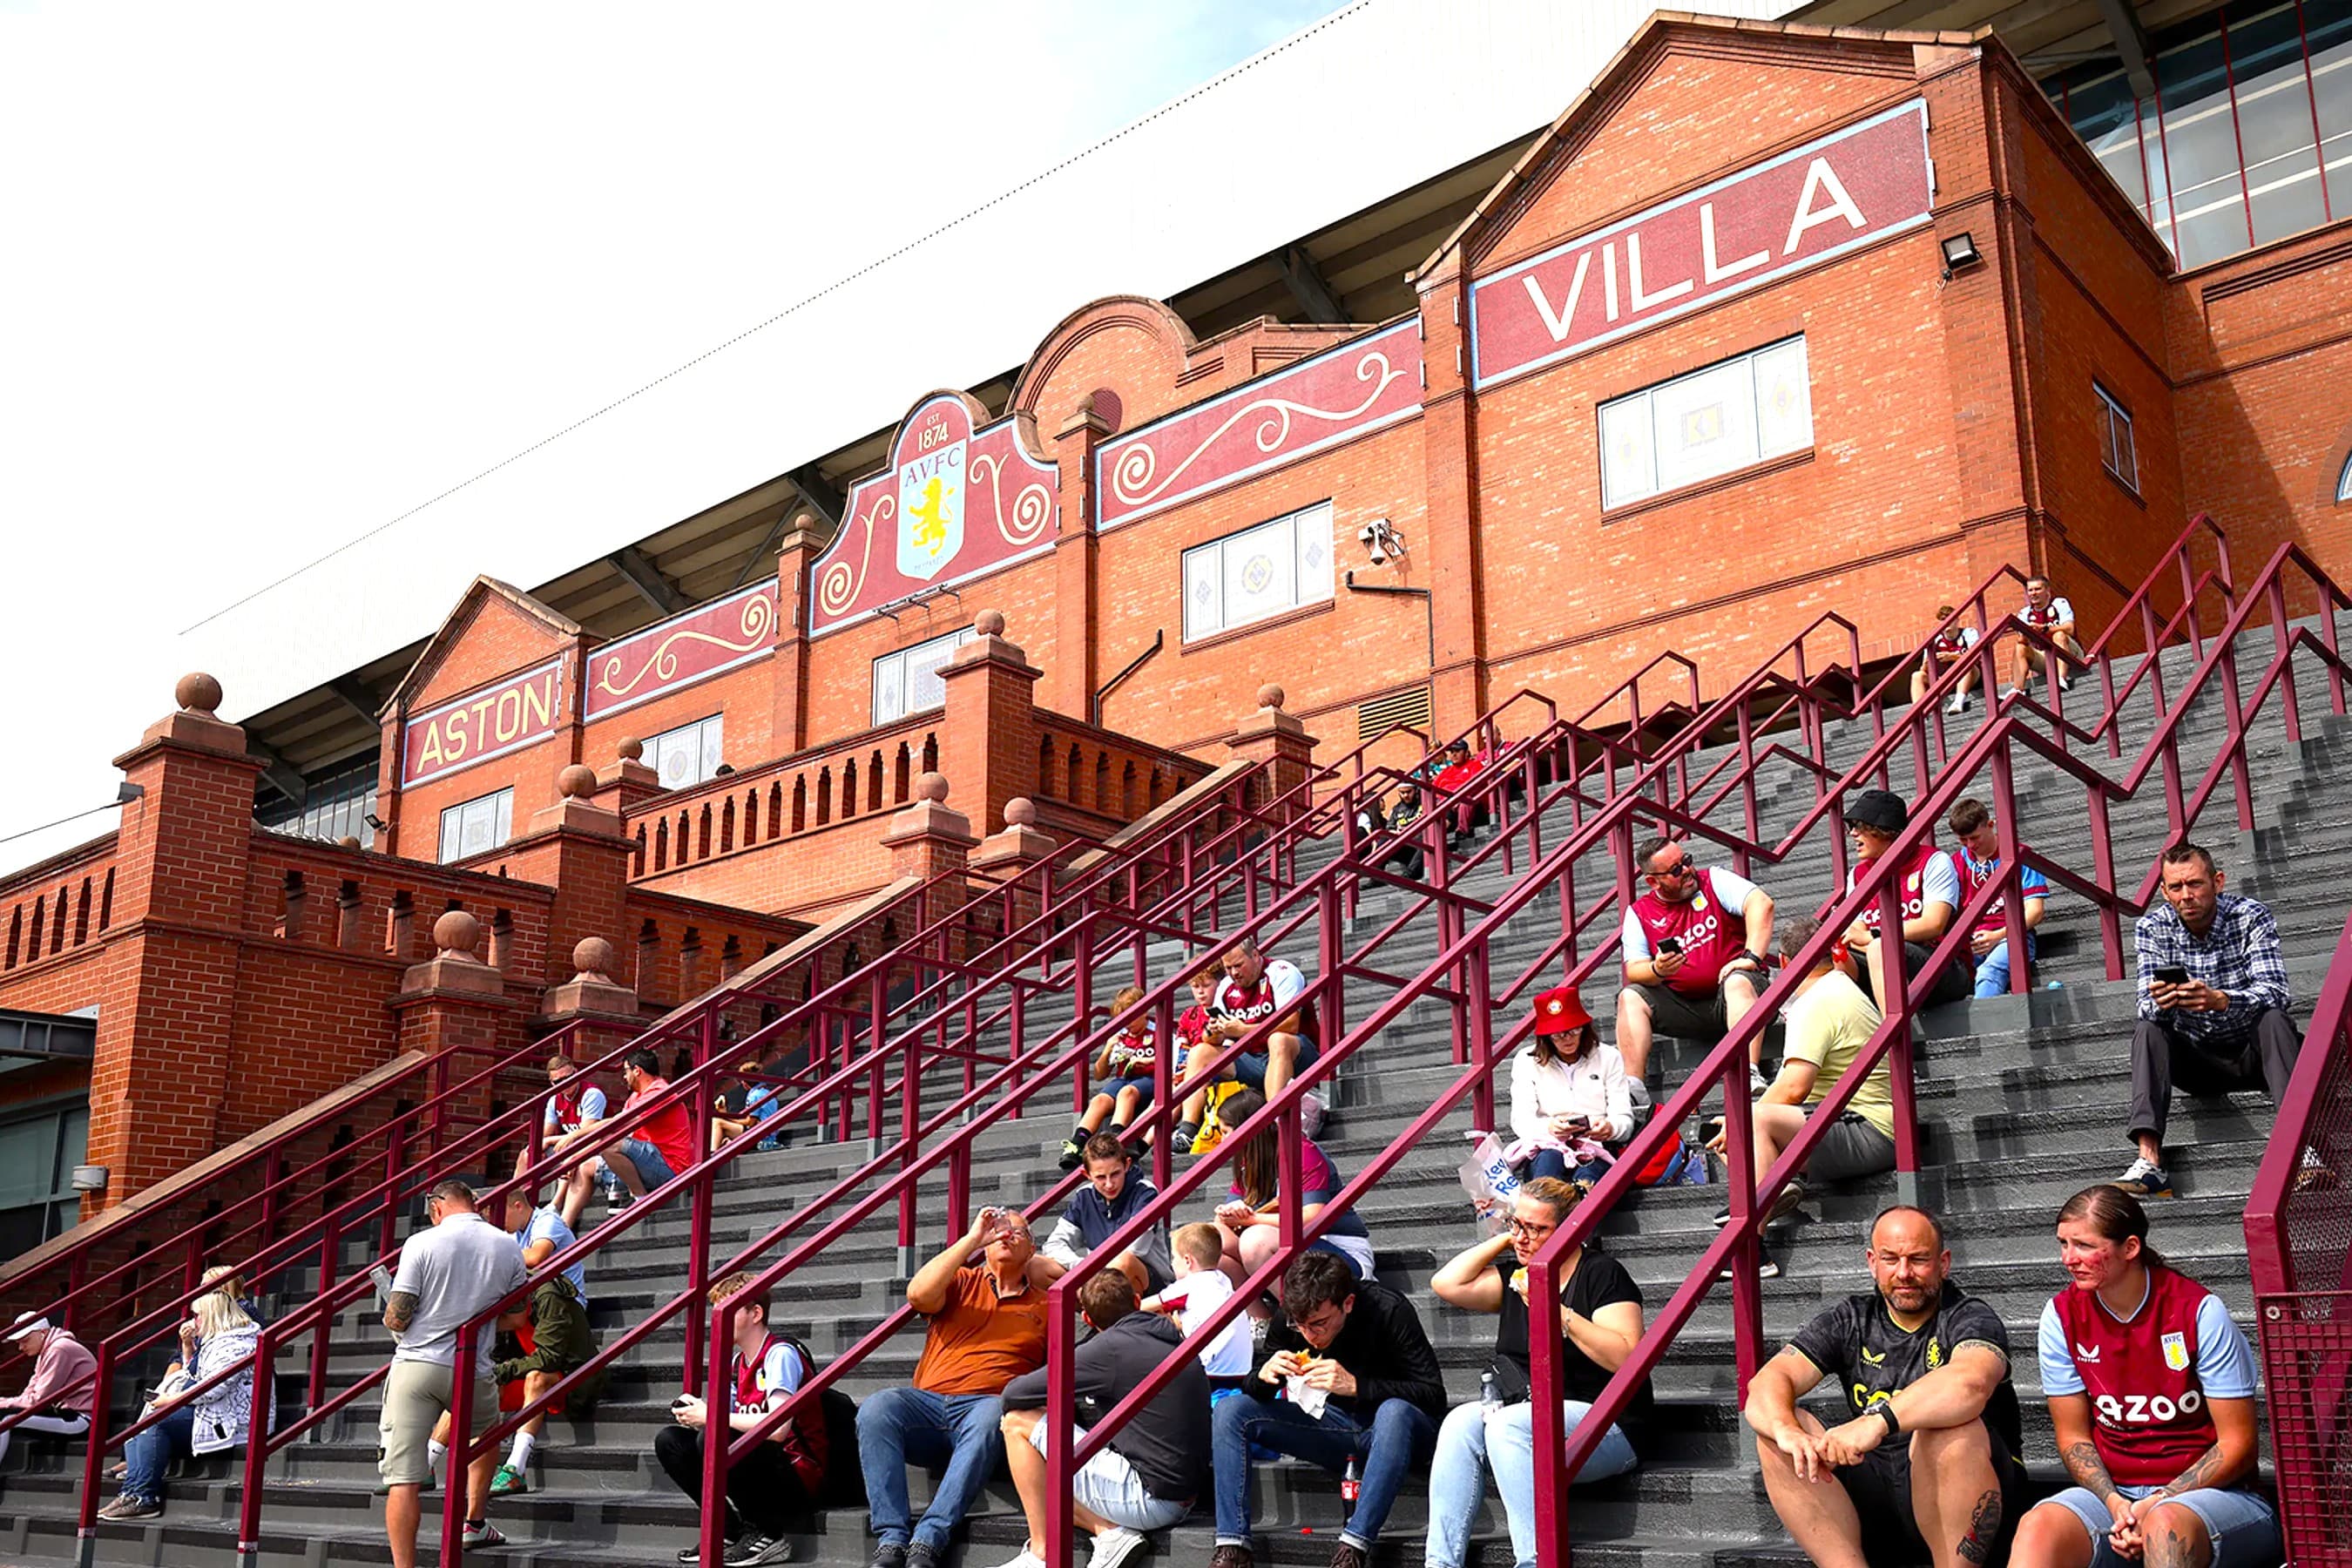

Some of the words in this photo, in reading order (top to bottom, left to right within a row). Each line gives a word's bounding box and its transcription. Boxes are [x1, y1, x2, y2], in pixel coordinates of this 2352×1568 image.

[1522, 155, 1868, 342] VILLA
[903, 447, 961, 488] AVFC
[918, 421, 950, 452] 1874
[416, 673, 552, 774] ASTON
